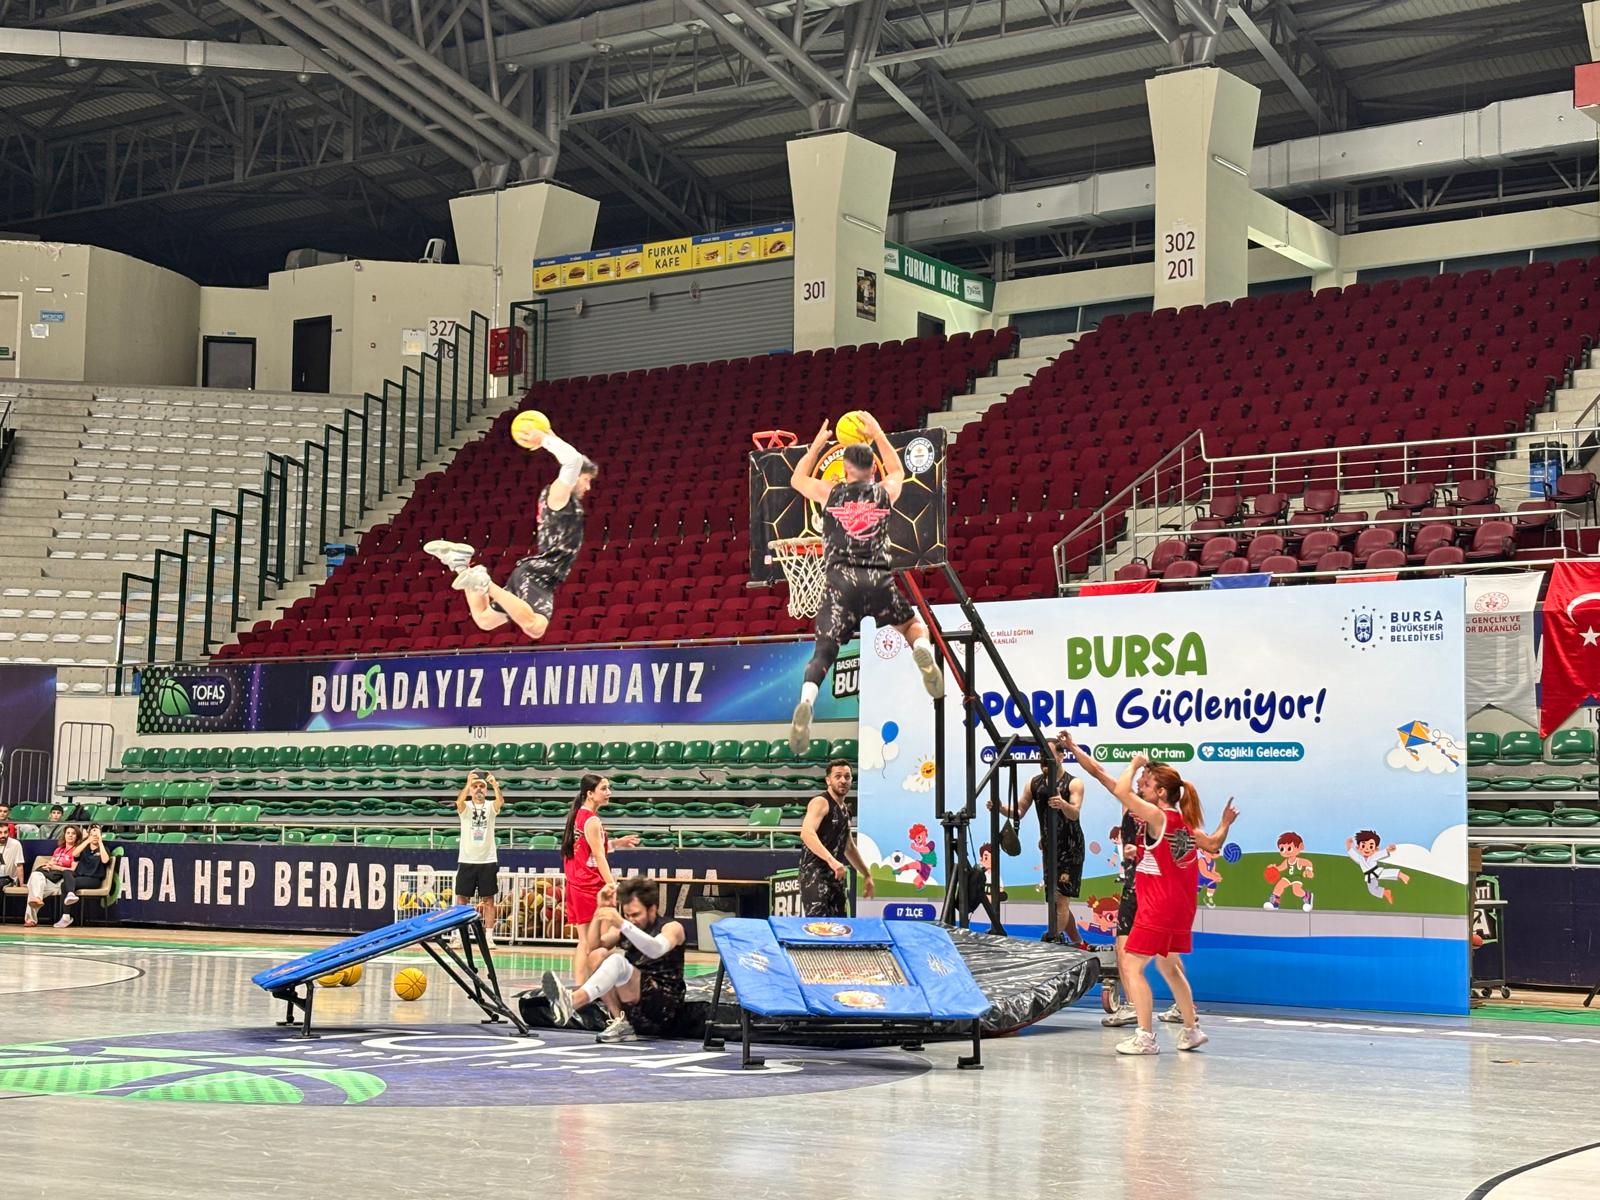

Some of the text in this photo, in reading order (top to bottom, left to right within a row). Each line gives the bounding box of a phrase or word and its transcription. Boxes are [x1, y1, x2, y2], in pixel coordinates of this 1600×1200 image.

[1165, 231, 1195, 253] 302
[648, 244, 687, 258] FURKAN
[655, 257, 680, 269] KAFE
[1168, 258, 1193, 280] 201
[904, 255, 935, 286] FURKAN
[941, 269, 959, 294] KAFE
[803, 281, 825, 300] 301
[429, 320, 456, 337] 327
[1391, 610, 1443, 623] BURSA
[1472, 615, 1507, 625] GENÇLİK
[1391, 622, 1443, 632] BÜYÜKŞEHİR
[1478, 623, 1521, 633] BAKANLIĞI
[993, 637, 1018, 645] KANLIĞI
[1391, 631, 1443, 642] BELEDİYESİ
[1067, 632, 1207, 680] BURSA
[835, 671, 860, 695] BU
[192, 684, 225, 704] TOFAŞ
[311, 662, 704, 719] BURSADAYIZ YANINDAYIZ
[473, 726, 486, 739] 101
[1151, 747, 1185, 759] Ortam
[1217, 746, 1299, 759] Sağlıklı Gelecek
[194, 859, 256, 906] HEP
[774, 880, 801, 893] BASKE
[774, 895, 805, 917] BU
[905, 907, 924, 919] İLÇE
